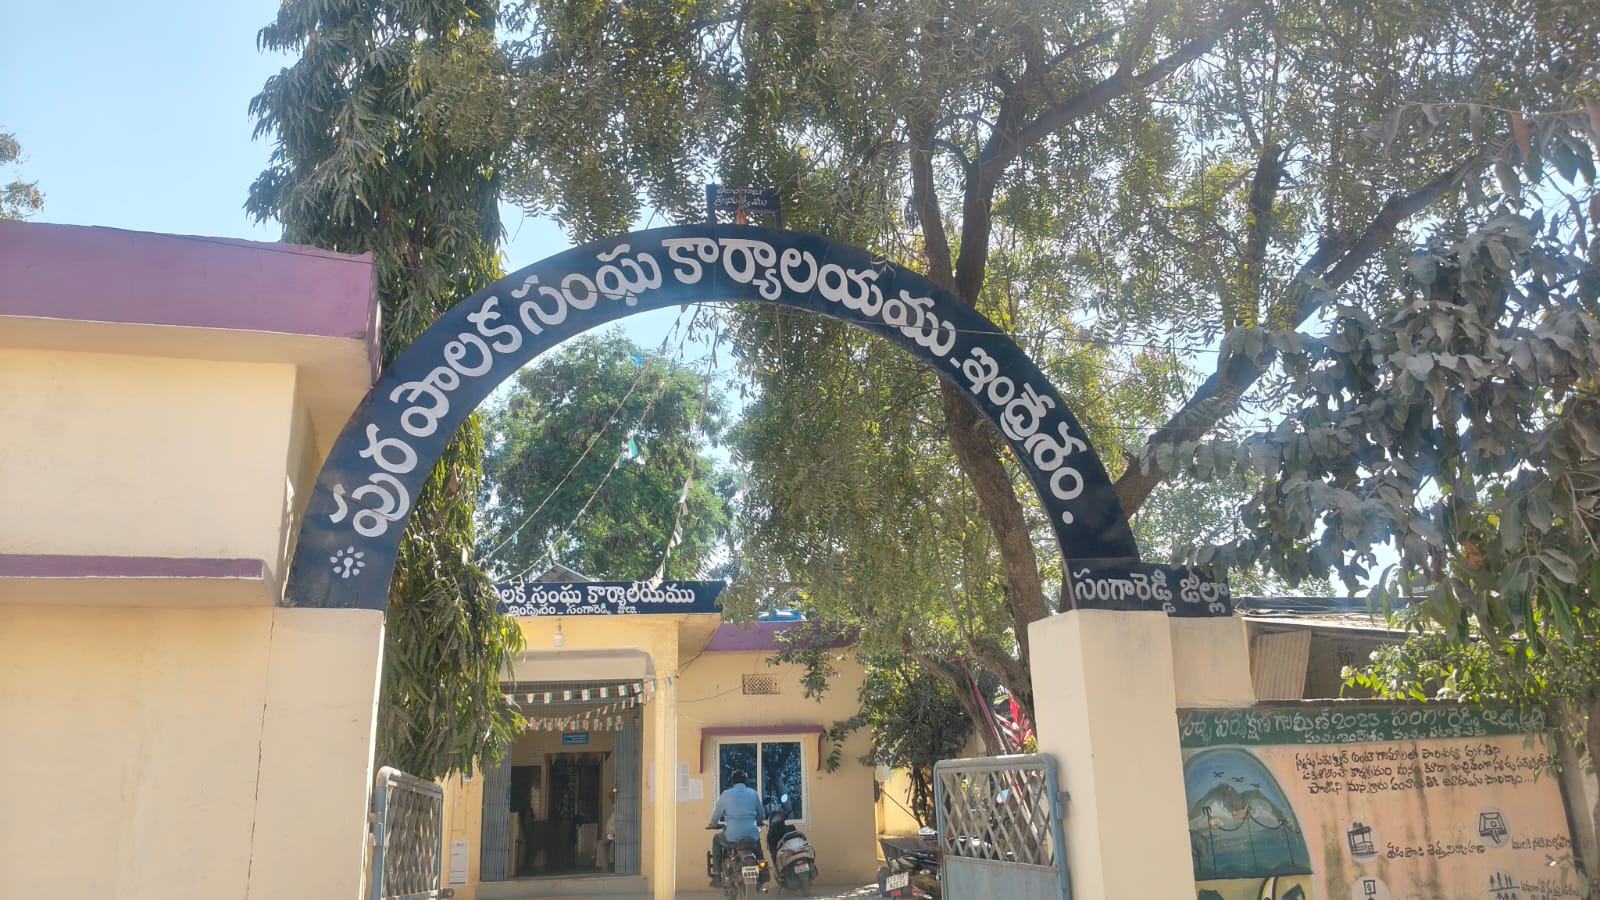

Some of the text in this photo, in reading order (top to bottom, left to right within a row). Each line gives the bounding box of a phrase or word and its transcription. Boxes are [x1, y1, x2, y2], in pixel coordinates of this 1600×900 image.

[388, 295, 523, 438] పాలక
[1072, 567, 1177, 614] సంగారెడ్డి
[1330, 711, 1380, 730] 2023
